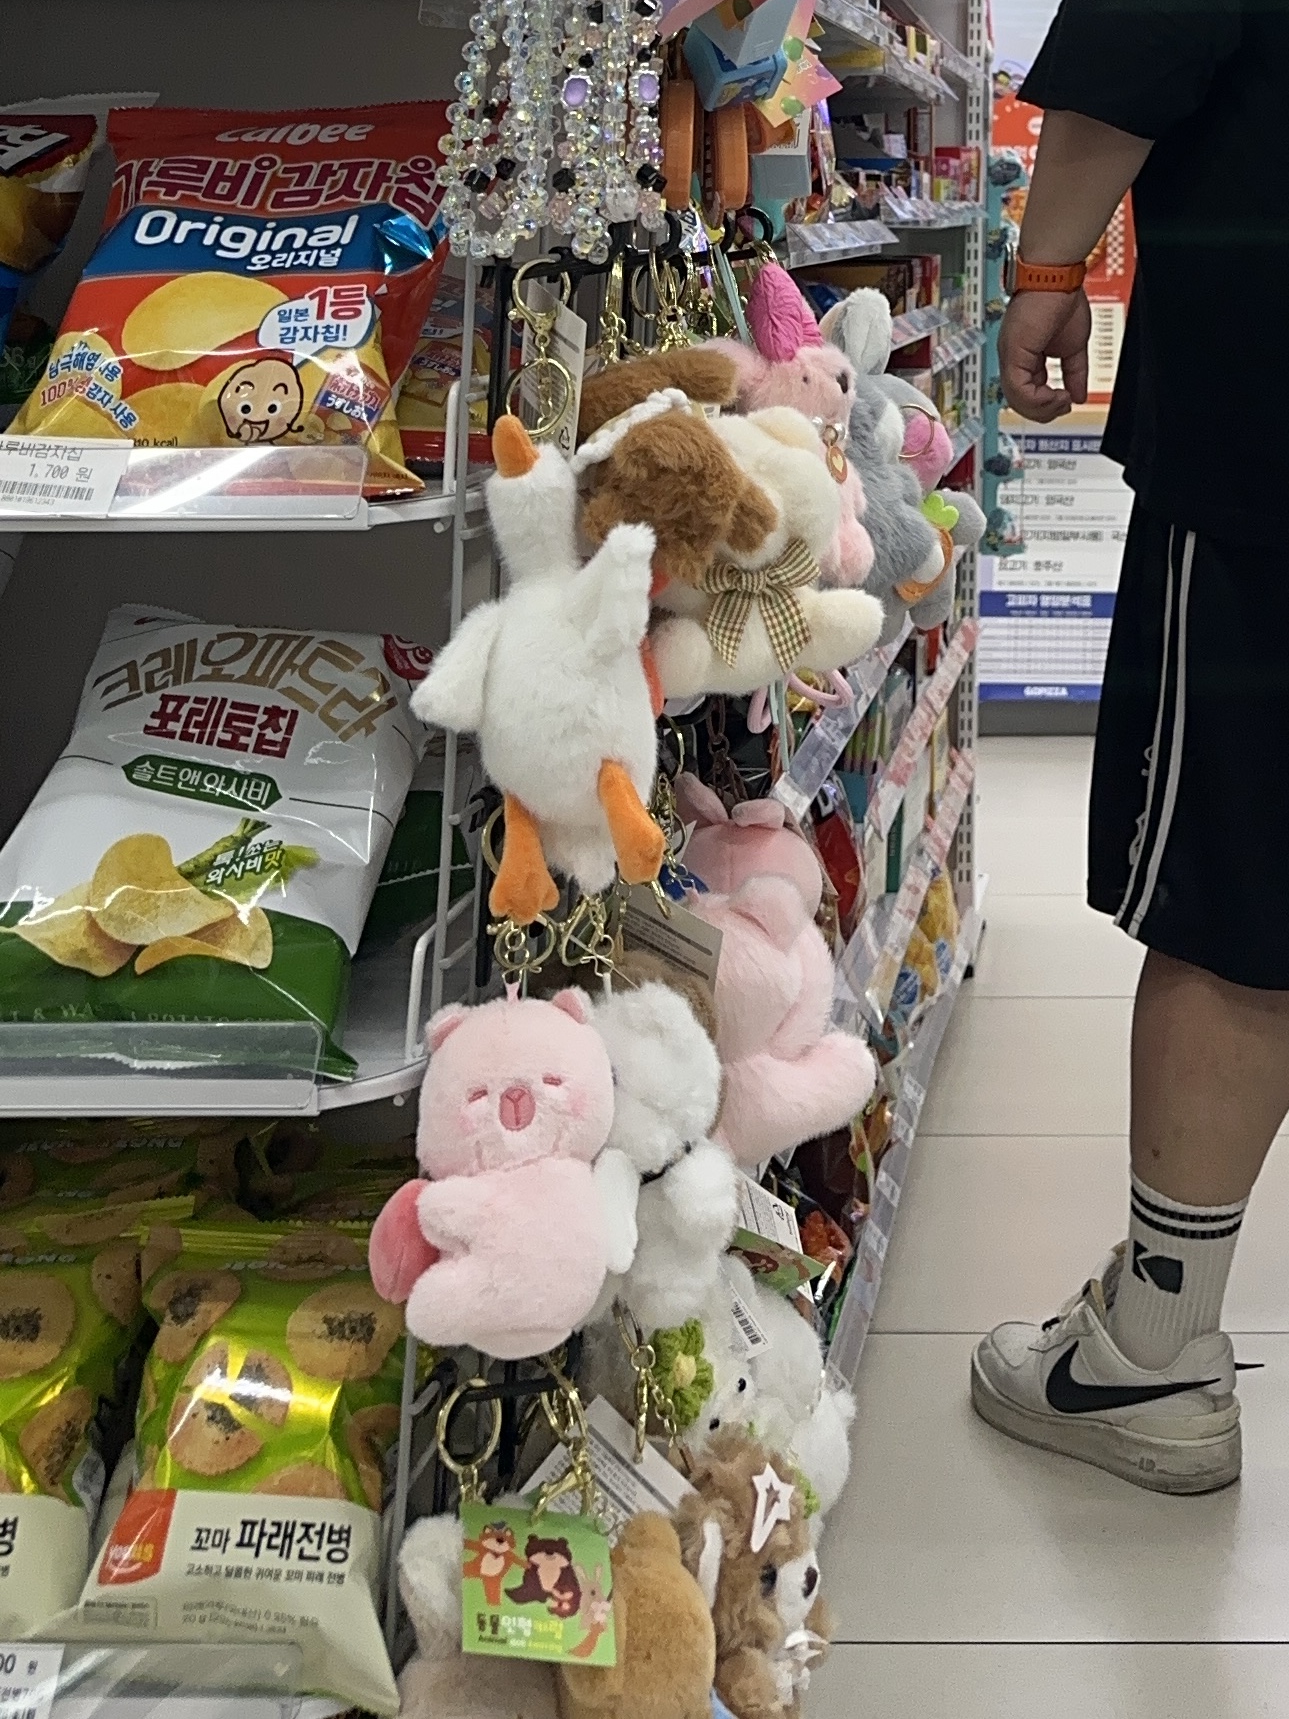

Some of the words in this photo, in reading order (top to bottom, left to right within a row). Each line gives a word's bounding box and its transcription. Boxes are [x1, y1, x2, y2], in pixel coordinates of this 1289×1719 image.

[134, 210, 360, 259] Original
[246, 248, 343, 271] 오리지널
[277, 308, 310, 324] 일본
[307, 285, 367, 322] 1등
[278, 324, 348, 345] 감자칩!
[110, 399, 139, 430] 사용
[76, 467, 93, 483] 원
[130, 760, 274, 807] 솔트앤와사비
[190, 1526, 231, 1554] 꼬마
[235, 1517, 353, 1565] 파래전병
